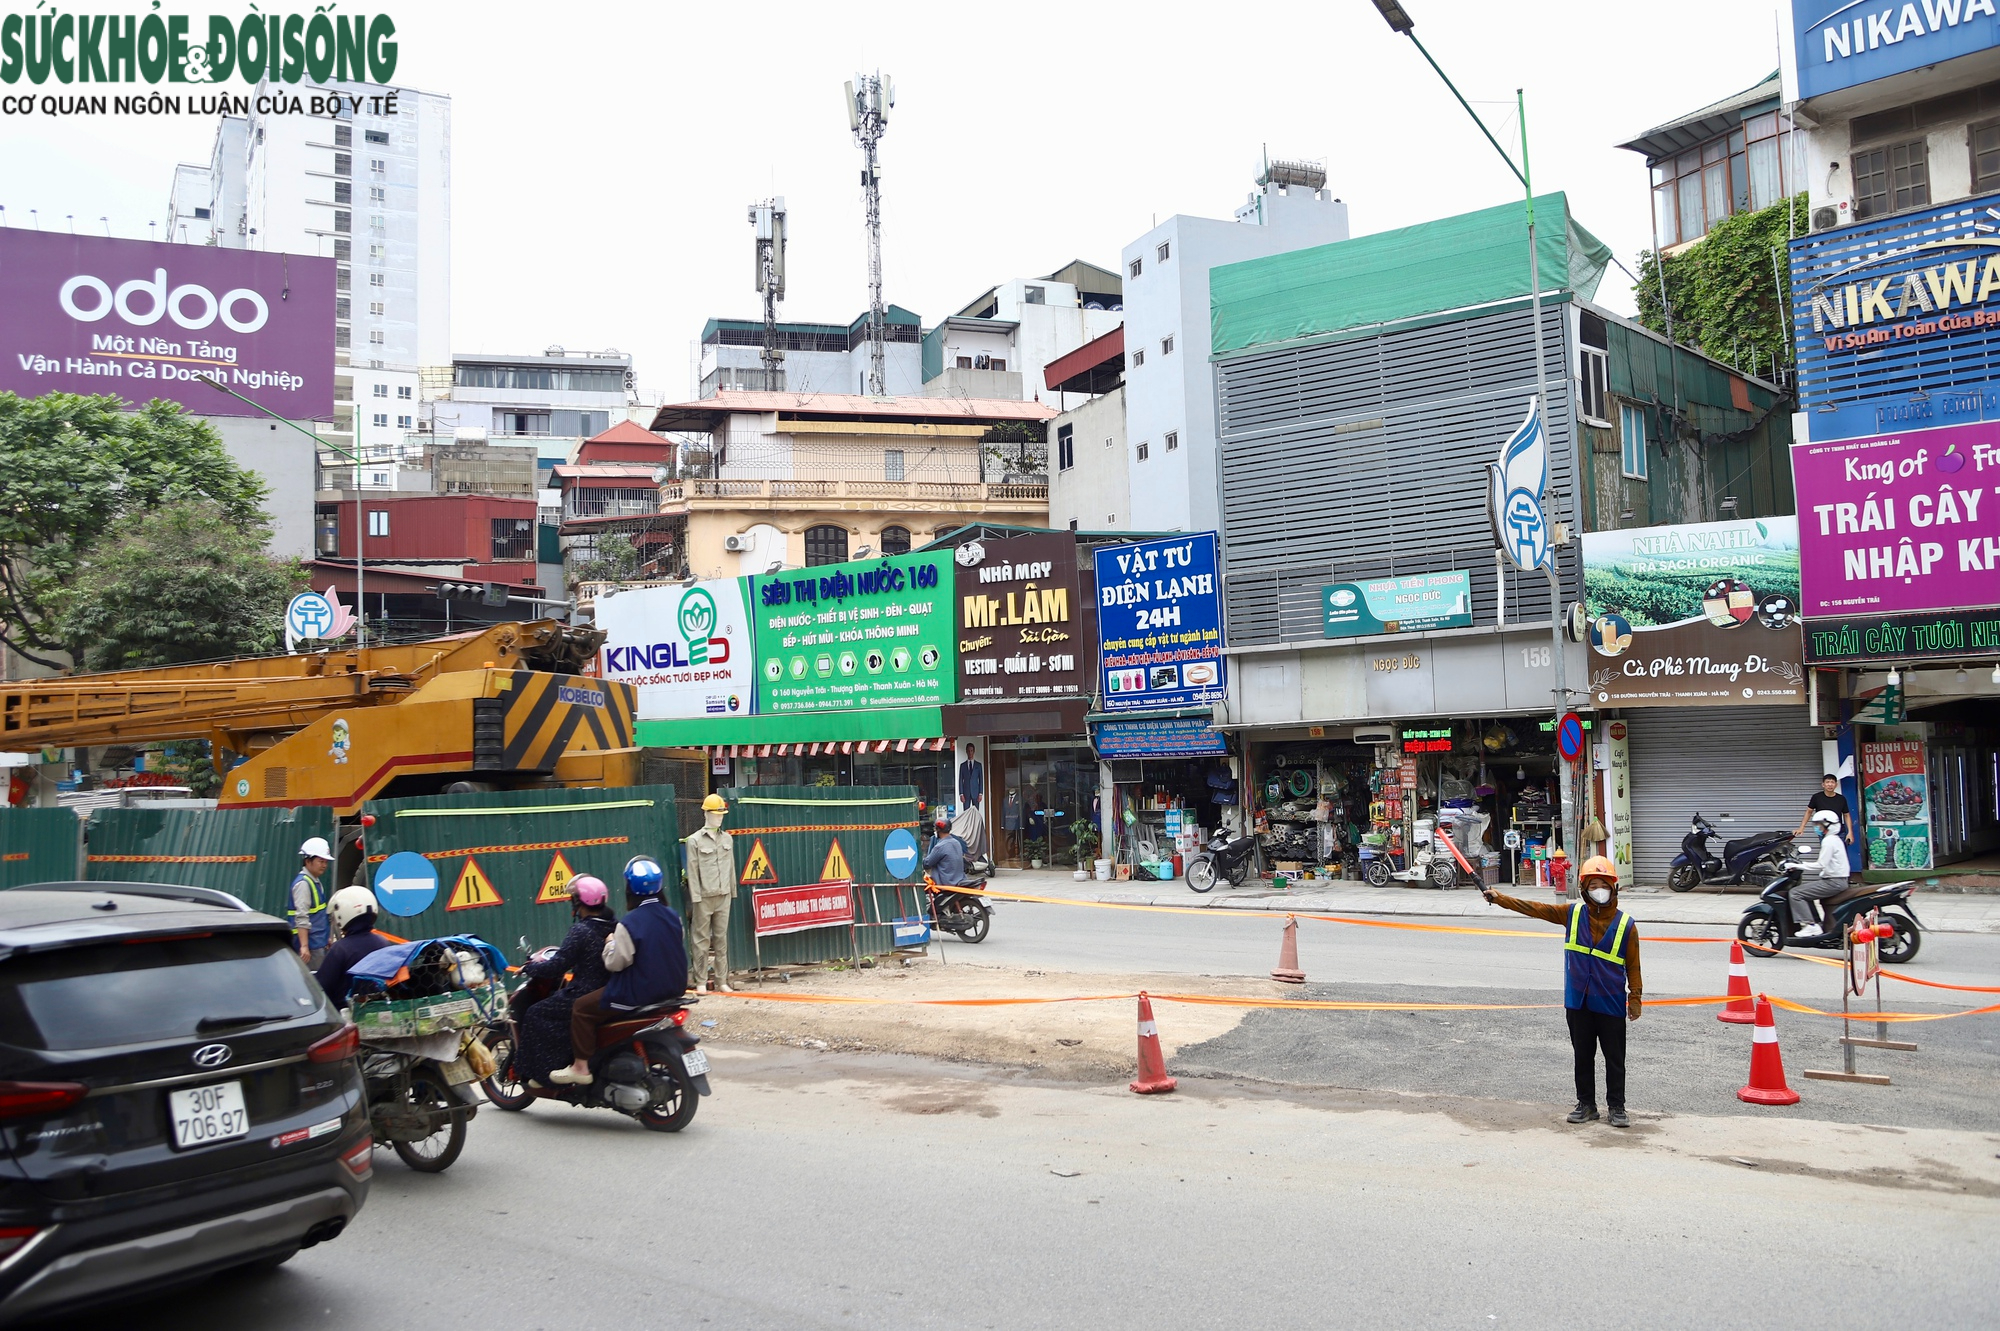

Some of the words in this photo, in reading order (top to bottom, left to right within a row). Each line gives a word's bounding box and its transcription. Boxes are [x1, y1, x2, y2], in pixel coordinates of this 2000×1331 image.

[59, 267, 270, 334] odoo
[1893, 320, 1937, 340] Toàn
[1938, 311, 1971, 333] Của
[92, 334, 135, 356] Một
[140, 336, 182, 356] Nền
[186, 340, 237, 363] Tảng
[18, 353, 60, 375] Vận
[65, 356, 123, 377] Hành
[128, 359, 156, 379] Cả
[233, 368, 304, 391] Nghiệp
[1844, 456, 1895, 485] King
[1898, 448, 1928, 478] of
[1813, 491, 1896, 536] TRÁI
[1908, 483, 1983, 527] CÂY
[1632, 531, 1684, 556] NHÀ
[1688, 529, 1757, 552] NAHL
[979, 560, 1013, 584] NHÀ
[1015, 561, 1052, 580] MAY
[1116, 547, 1158, 578] VẬT
[1163, 541, 1193, 568] TƯ
[1631, 558, 1657, 573] TRÀ
[1659, 559, 1697, 574] SẠCH
[1699, 553, 1766, 568] ORGANIC
[1843, 536, 1944, 584] NHẬP
[762, 577, 791, 606] SIÊU
[793, 578, 817, 607] THỊ
[819, 569, 854, 604] ĐIỆN
[857, 560, 905, 595] NƯỚC
[908, 563, 938, 589] 160
[1102, 578, 1150, 609] ĐIỆN
[1155, 573, 1213, 604] LẠNH
[1368, 581, 1398, 593] NHỰA
[1401, 577, 1425, 590] TIỀN
[1428, 574, 1464, 587] PHONG
[963, 583, 1069, 628] Mr.LÂM
[1395, 593, 1420, 605] NGỌC
[1422, 589, 1441, 602] ĐỨC
[769, 613, 786, 631] ĐIỆN
[788, 611, 811, 627] NƯỚC
[817, 606, 837, 624] THIẾT
[838, 610, 847, 625] BỊ
[849, 606, 859, 624] VỆ
[860, 607, 879, 620] SINH
[886, 602, 903, 618] ĐÈN
[909, 602, 932, 616] QUẠT
[1136, 605, 1181, 630] 24H
[783, 632, 797, 648] BẾP
[802, 629, 817, 646] HÚT
[819, 629, 834, 644] MÙI
[839, 627, 863, 642] KHÓA
[865, 624, 894, 640] THÔNG
[896, 624, 919, 637] MINH
[959, 635, 992, 654] Chuyên:
[1019, 628, 1040, 644] Sài
[1041, 627, 1070, 644] Gòn
[1103, 637, 1127, 652] chuyên
[1127, 637, 1144, 650] cung
[1145, 631, 1157, 649] cấp
[1158, 633, 1169, 648] vật
[1170, 632, 1179, 643] tư
[1180, 629, 1201, 645] ngành
[1202, 627, 1219, 644] lạnh
[1812, 625, 1860, 656] TRÁI
[1865, 622, 1907, 654] CÂY
[1912, 619, 1964, 651] TƯƠI
[606, 637, 730, 673] KINGLED
[965, 658, 998, 675] VESTON
[1028, 653, 1041, 673] ÂU
[1373, 658, 1399, 674] NGỌC
[1403, 653, 1421, 670] ĐỨC
[1520, 647, 1551, 668] 158
[650, 672, 672, 684] SỐNG
[673, 671, 692, 683] TƯƠI
[694, 671, 711, 683] ĐẸP
[712, 669, 732, 680] HƠN
[1623, 659, 1647, 677] Cà
[1649, 656, 1685, 678] Phê
[1686, 656, 1742, 682] Mang
[1744, 654, 1770, 674] Đi
[559, 686, 604, 707] KOBELCO
[780, 688, 790, 697] 160
[791, 685, 814, 698] Nguyễn
[830, 684, 853, 694] Thượng
[854, 682, 869, 692] Đình
[872, 681, 892, 690] Thanh
[893, 680, 911, 689] Xuân
[916, 679, 926, 688] Hà
[927, 678, 939, 689] Nội
[1404, 739, 1426, 754] ĐIỆN
[1427, 738, 1452, 752] NƯỚC
[1904, 741, 1919, 753] VỤ
[1865, 753, 1895, 774] USA
[555, 870, 564, 881] ĐI
[760, 902, 776, 919] CÔNG
[776, 898, 796, 917] TRƯỜNG
[796, 899, 810, 914] ĐANG
[810, 898, 819, 912] THI
[818, 895, 832, 911] CÔNG
[189, 1086, 225, 1114] 30F
[178, 1110, 244, 1143] 706.97
